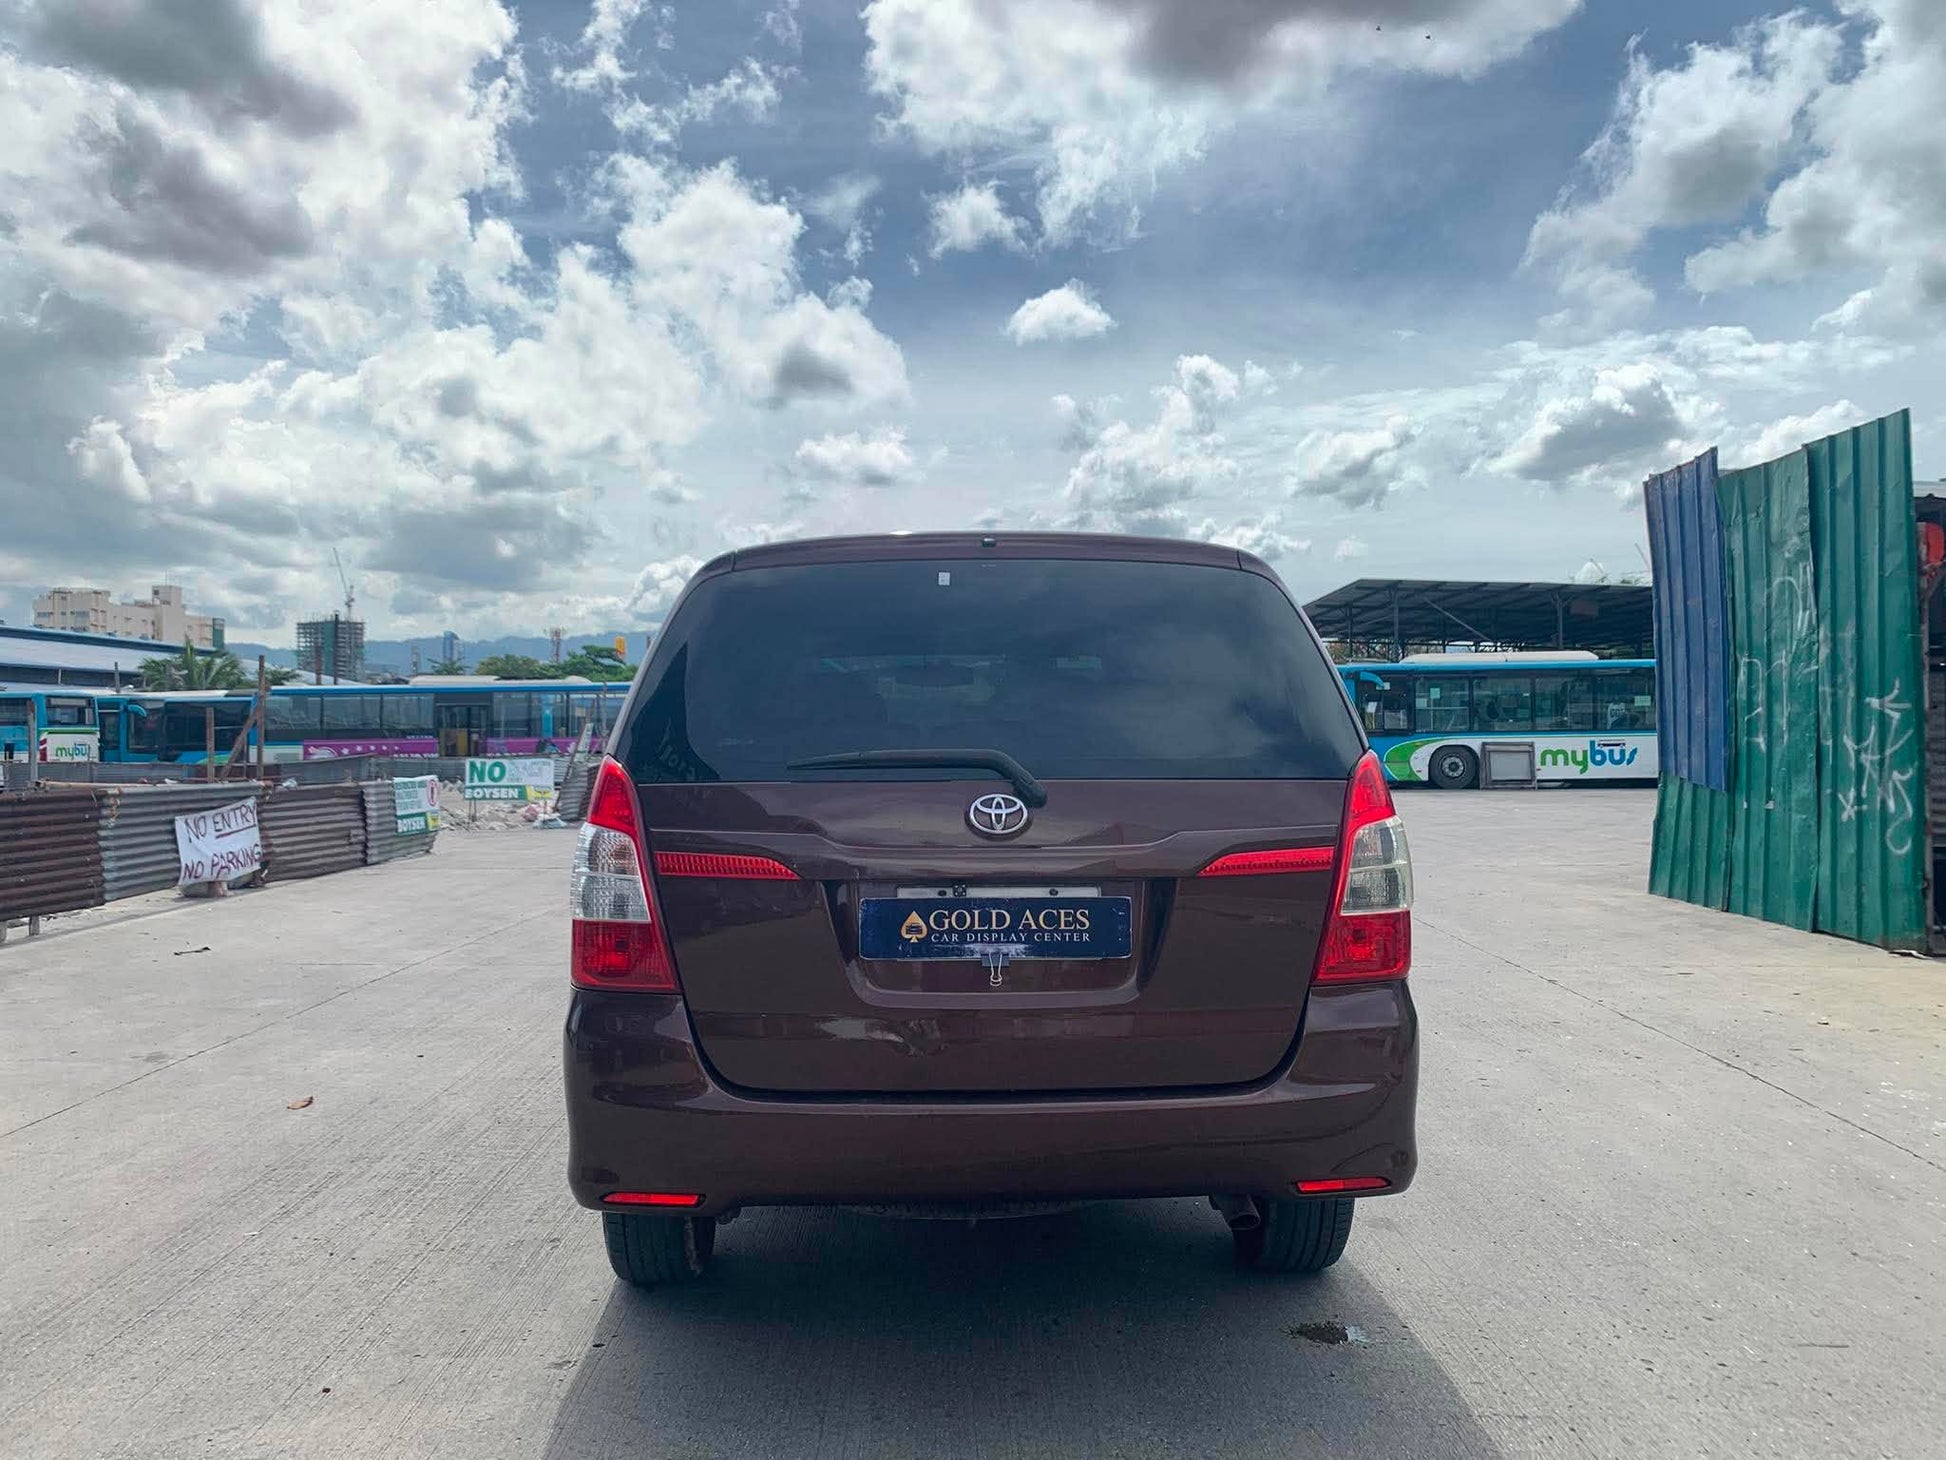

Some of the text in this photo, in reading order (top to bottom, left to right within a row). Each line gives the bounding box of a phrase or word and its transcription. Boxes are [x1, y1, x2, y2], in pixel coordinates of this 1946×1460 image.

[1540, 739, 1638, 775] mybus
[469, 761, 506, 783] NO
[465, 788, 518, 799] BOYSEN
[184, 804, 256, 843] NO ENTRY
[182, 843, 262, 879] NO PARKING
[928, 909, 1091, 931] GOLD ACES
[931, 932, 1091, 943] CAR DISPLAY CENTER
